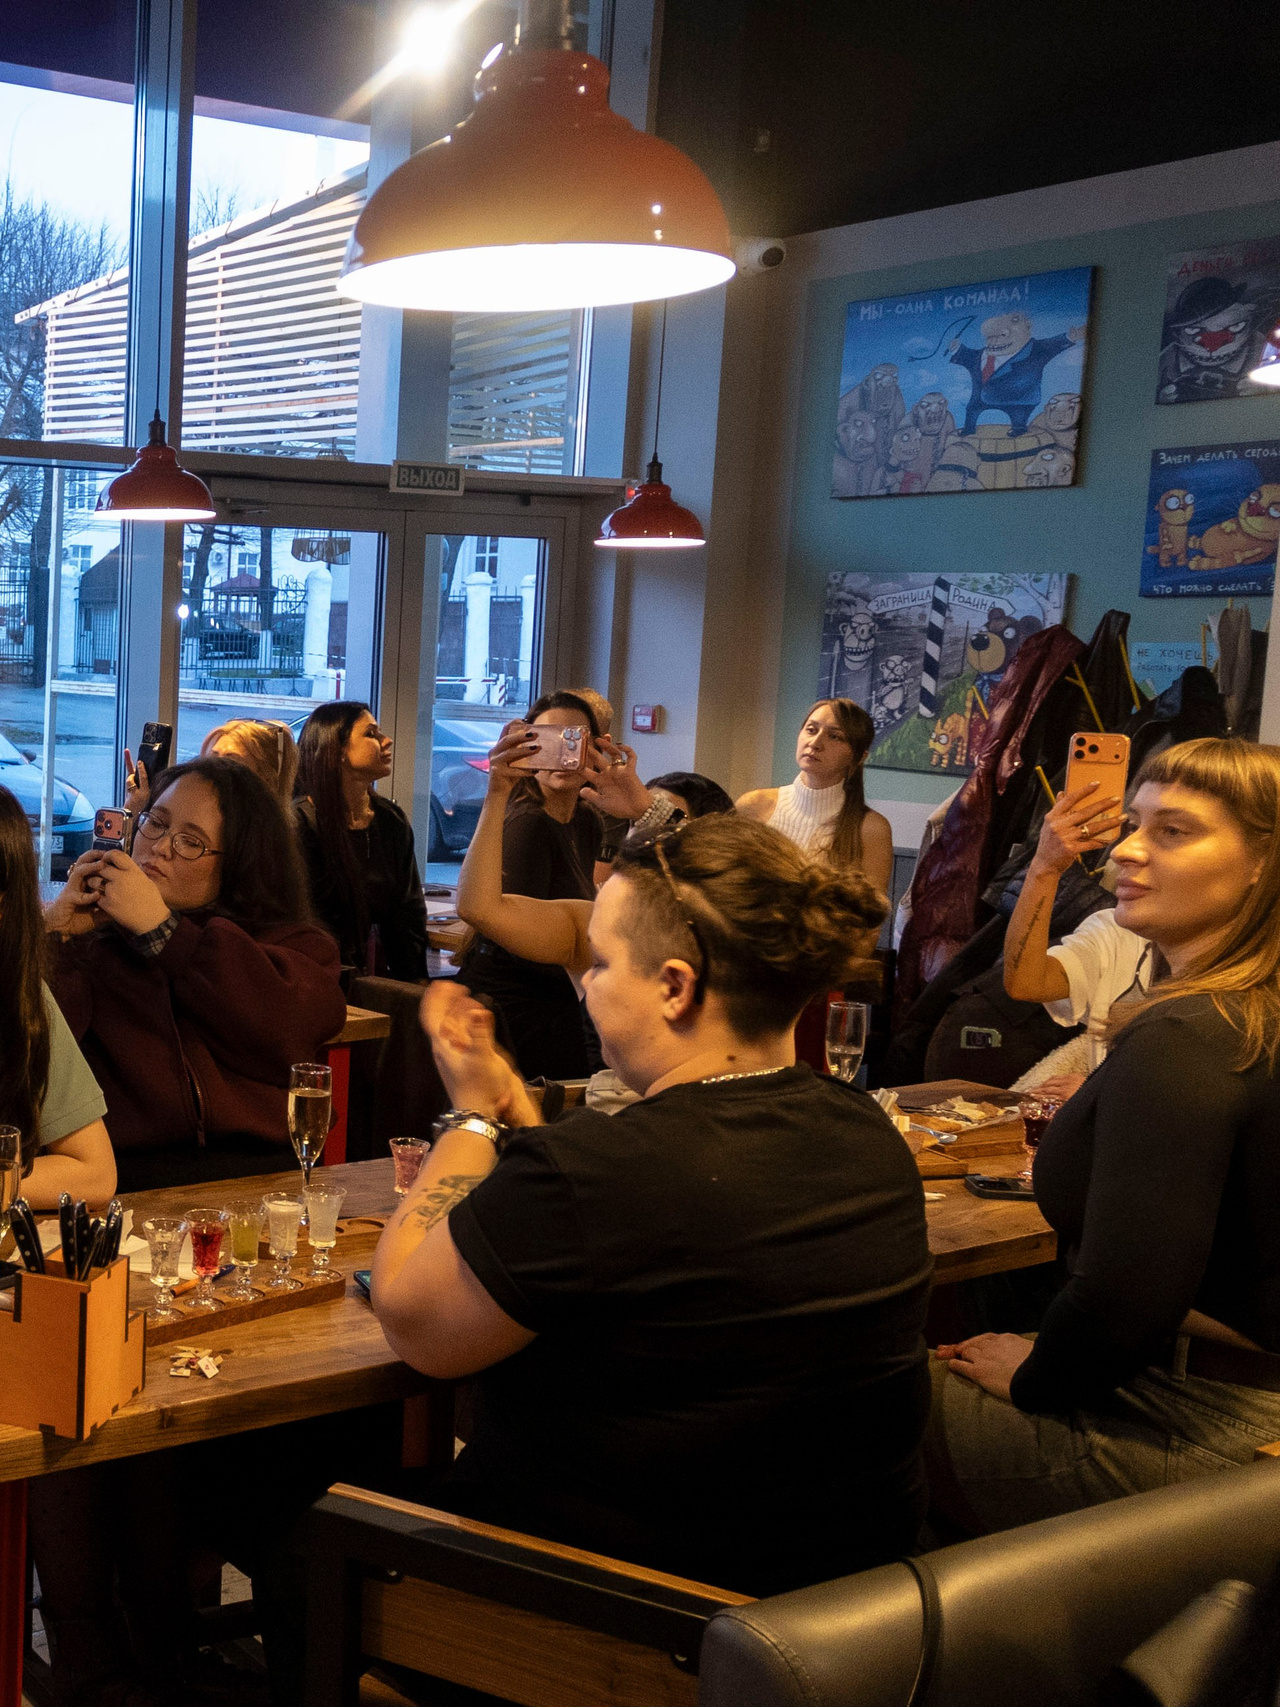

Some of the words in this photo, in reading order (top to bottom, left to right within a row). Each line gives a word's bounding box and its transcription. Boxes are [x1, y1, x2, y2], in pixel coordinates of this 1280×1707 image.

[944, 279, 1030, 311] КОМАНДА!
[1196, 450, 1238, 463] ДЕЛАТЬ
[1244, 448, 1280, 459] СЕГОД
[400, 467, 457, 488] ВЫХОД
[1153, 584, 1173, 595] ЧТО
[1179, 584, 1213, 594] МОЖНО
[1217, 581, 1263, 592] СДЕЛАТЬ
[874, 589, 932, 611] ЗАГРАНИЦА
[1137, 648, 1149, 657] НЕ
